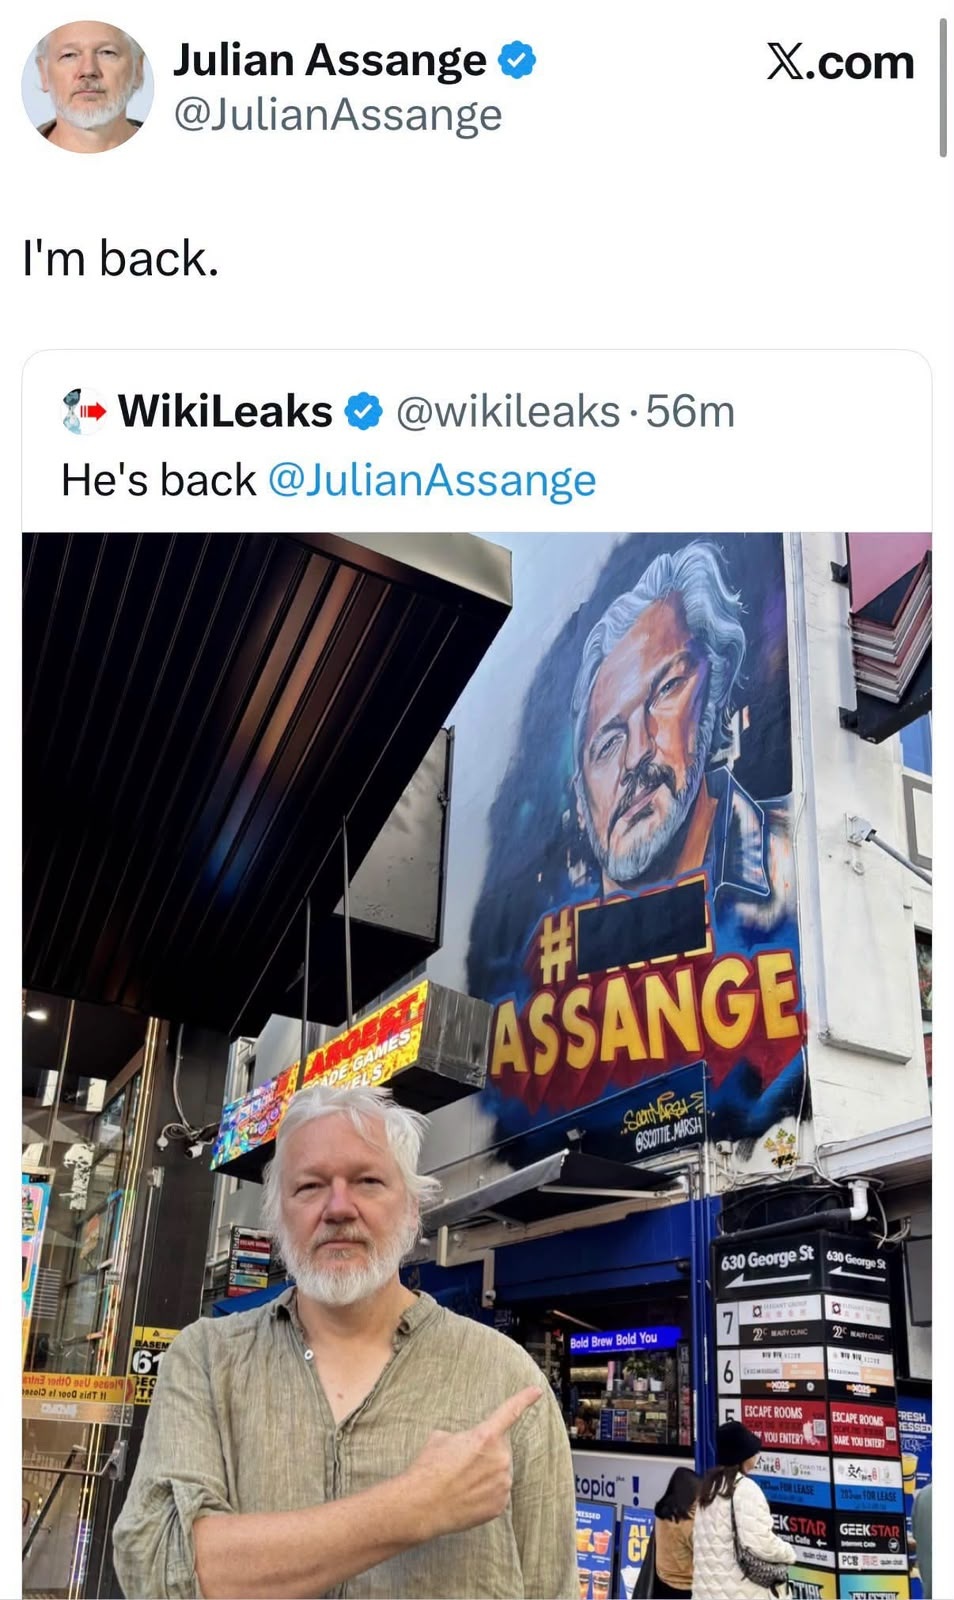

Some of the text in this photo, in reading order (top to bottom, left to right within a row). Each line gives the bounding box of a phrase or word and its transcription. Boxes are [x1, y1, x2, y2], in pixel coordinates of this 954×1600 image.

[490, 950, 800, 1076] ASSANGE
[353, 1028, 411, 1071] GAMES
[721, 1245, 814, 1271] 630 George St
[826, 1250, 886, 1270] 630 George St
[723, 1311, 733, 1335] 7
[134, 1340, 170, 1350] BASEM
[570, 1331, 658, 1349] Bold Brew Bold You
[723, 1360, 733, 1384] 6
[725, 1409, 735, 1422] 5
[744, 1405, 773, 1417] ESCAPE
[774, 1407, 803, 1419] ROOMS
[832, 1412, 858, 1425] ESCAPE
[859, 1414, 884, 1427] ROOMS
[764, 1432, 778, 1443] YOU
[780, 1433, 804, 1445] ENTER?
[833, 1435, 885, 1449] DARE YOU ENTER?
[794, 1484, 815, 1496] LEASE
[863, 1489, 876, 1501] FOR
[877, 1491, 897, 1502] LEASE
[839, 1523, 900, 1537] GEEKSTAR
[795, 1535, 811, 1545] Cafe
